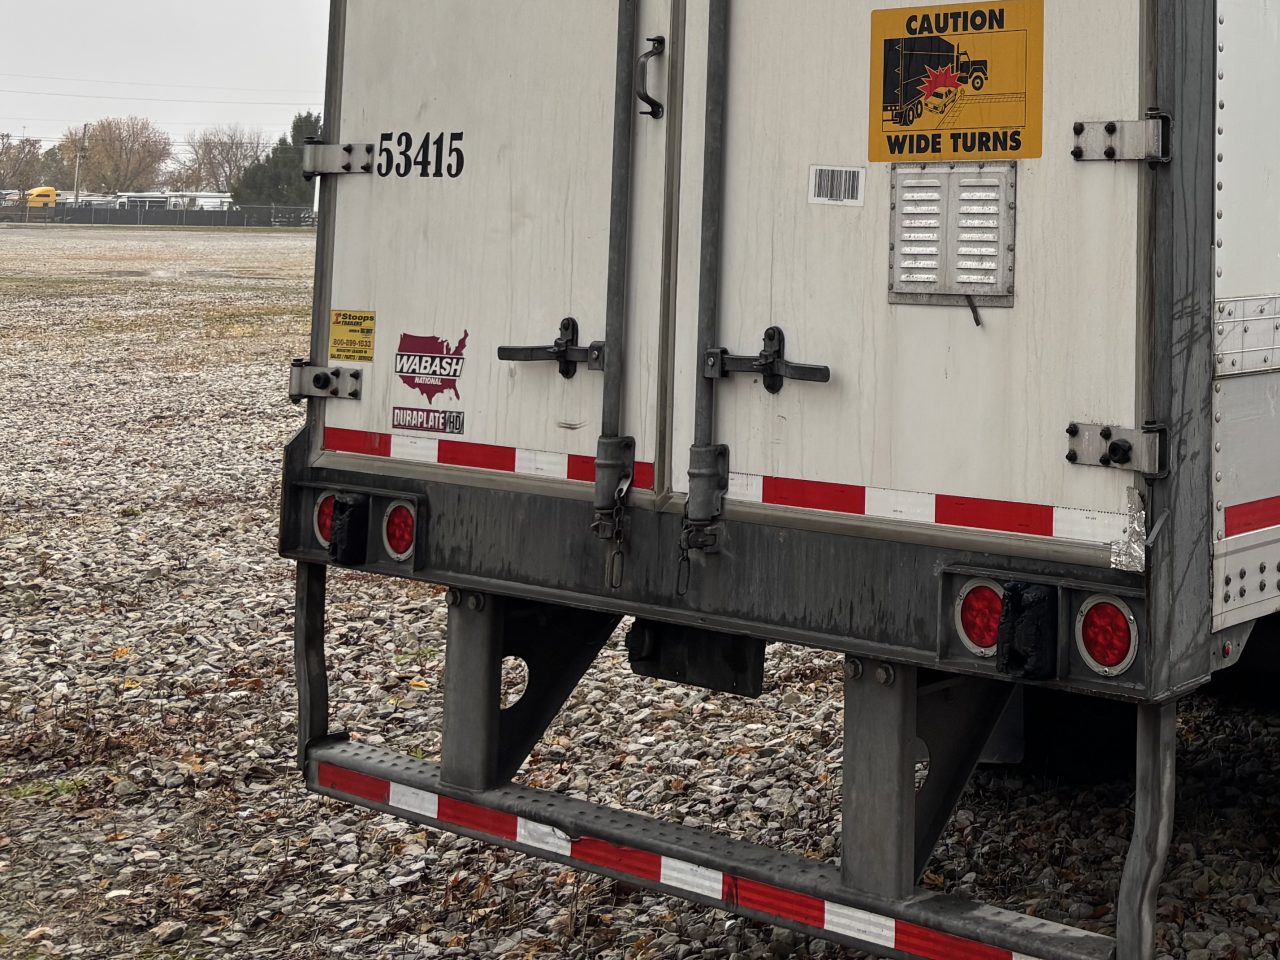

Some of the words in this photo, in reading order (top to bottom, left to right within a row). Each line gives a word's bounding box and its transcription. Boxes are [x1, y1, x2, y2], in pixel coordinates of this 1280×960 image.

[906, 8, 1005, 35] CAUTION
[886, 133, 942, 154] WIDE
[950, 130, 1022, 152] TURNS
[377, 131, 464, 178] 53415
[341, 312, 375, 322] Stoops
[396, 355, 463, 376] WABASH
[415, 376, 442, 385] NATIONAL
[394, 409, 445, 429] DURAPLATE
[448, 413, 461, 431] HD
